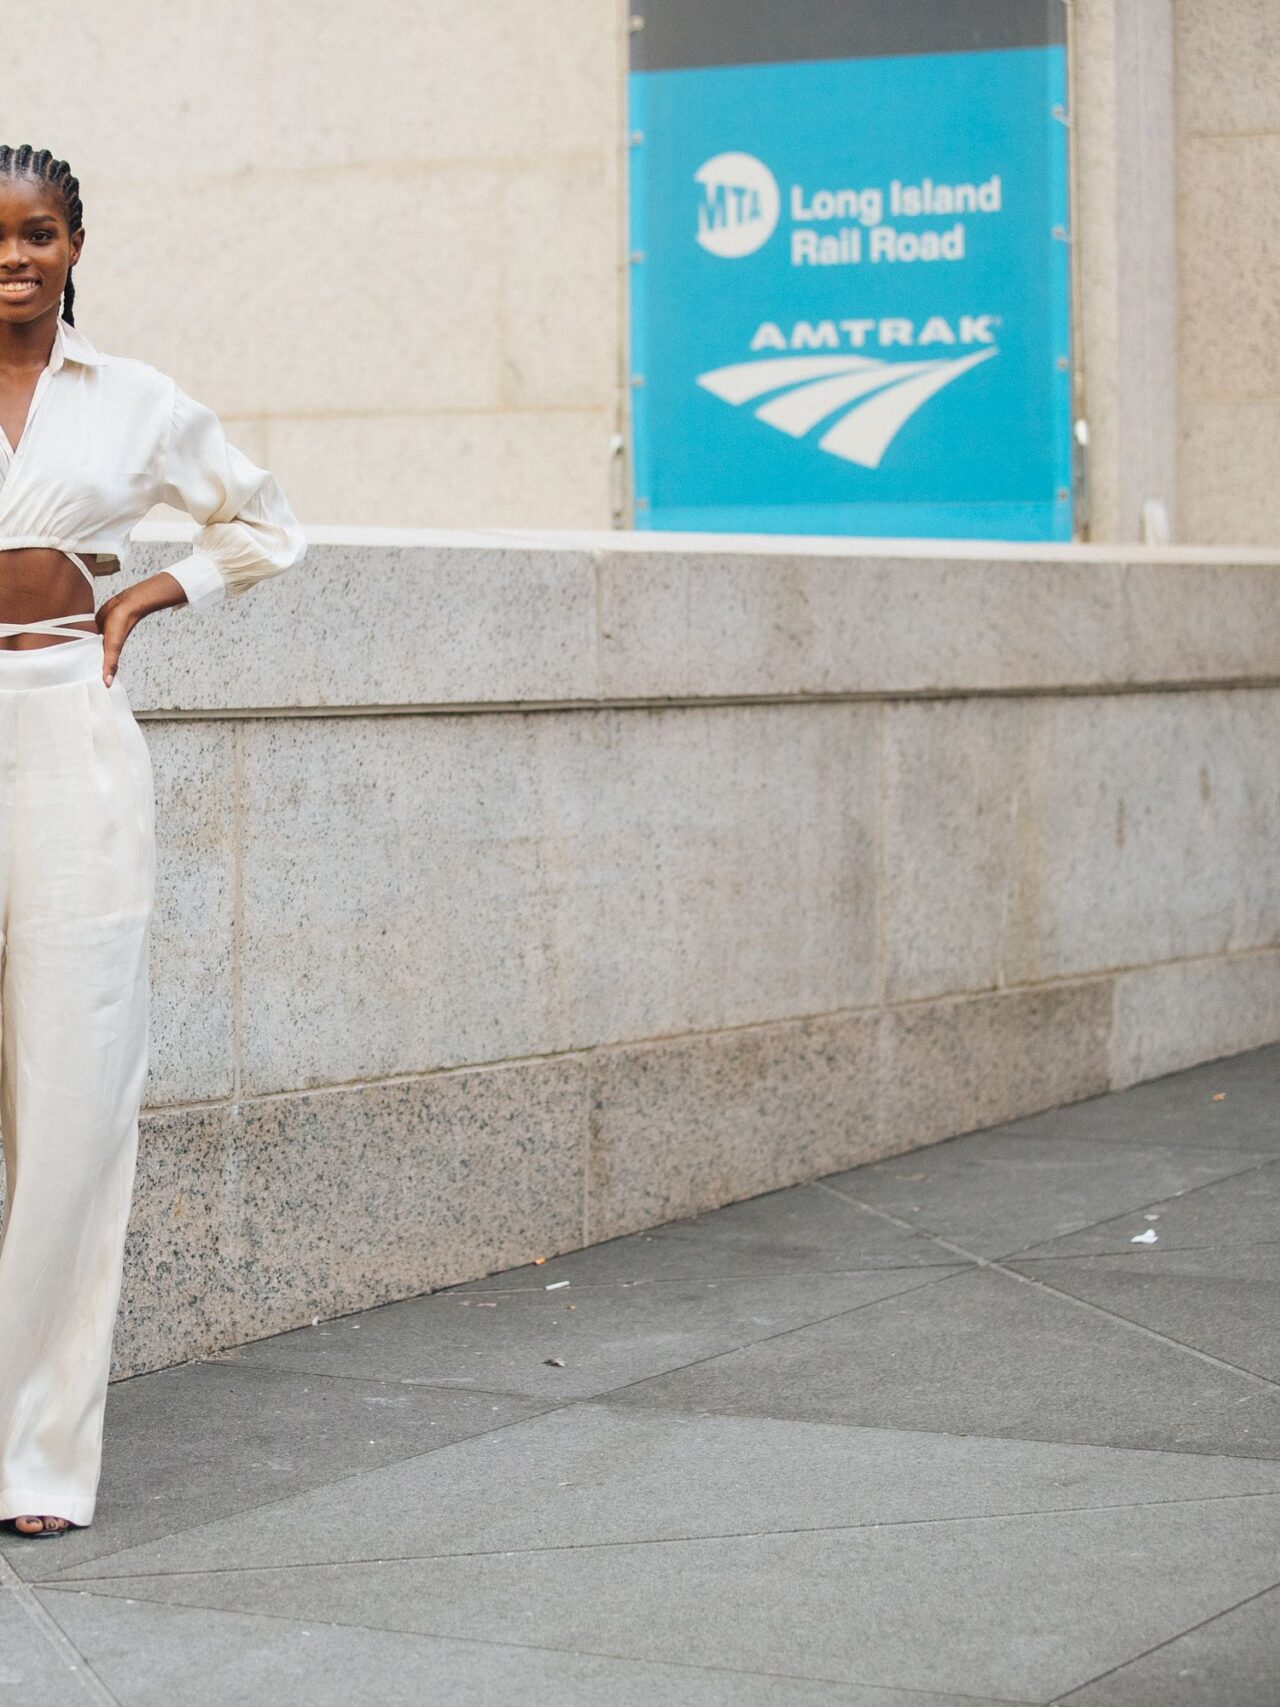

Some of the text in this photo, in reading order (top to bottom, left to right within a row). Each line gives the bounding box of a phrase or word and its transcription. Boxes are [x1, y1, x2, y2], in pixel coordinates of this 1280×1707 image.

[792, 176, 1001, 225] Long Island
[792, 224, 965, 266] Rail Road
[750, 315, 995, 350] AMTRAK
